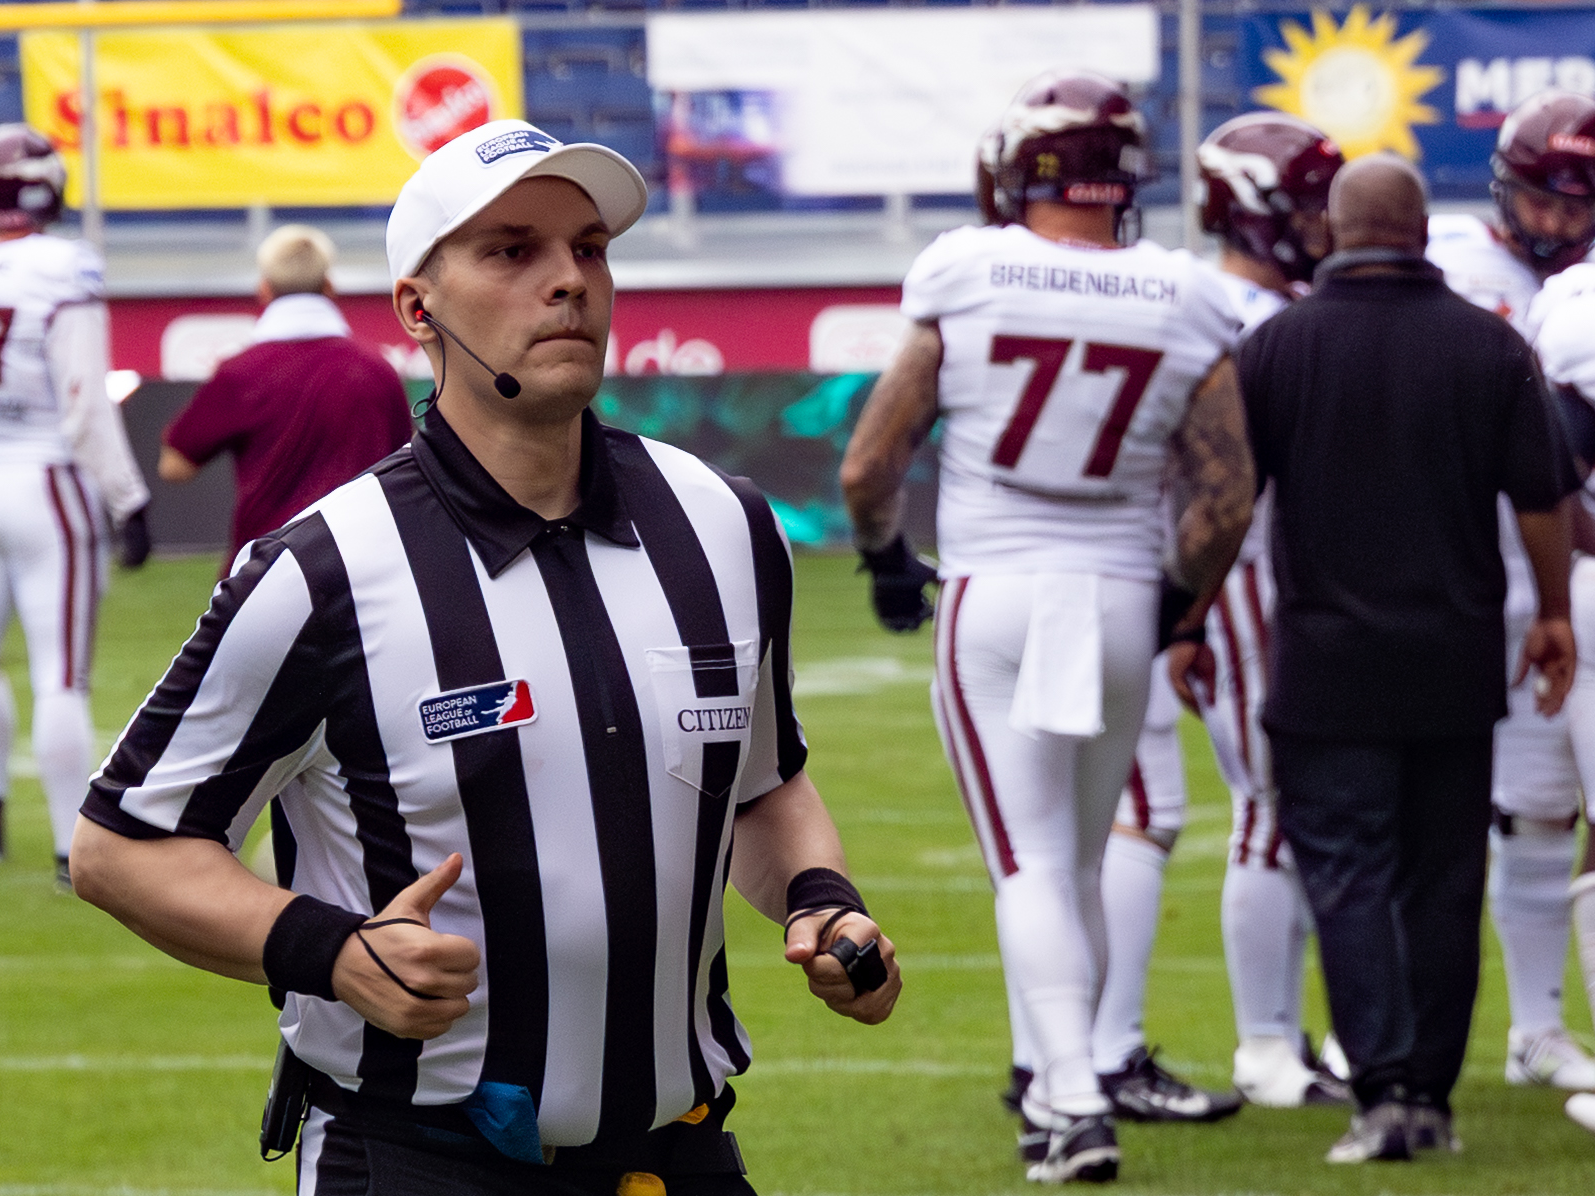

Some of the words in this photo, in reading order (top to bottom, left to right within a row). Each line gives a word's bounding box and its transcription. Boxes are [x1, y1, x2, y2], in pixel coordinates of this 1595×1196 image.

[50, 87, 375, 150] Sinalco
[477, 131, 529, 153] EUROPEAN
[483, 142, 534, 162] FOOTBALL
[989, 253, 1178, 303] BREIDENBACH
[988, 334, 1165, 478] 77
[422, 695, 477, 715] EUROPEAN
[425, 708, 463, 724] LEAGUE
[427, 716, 479, 735] FOOTBALL
[677, 706, 751, 732] CITIZEN
